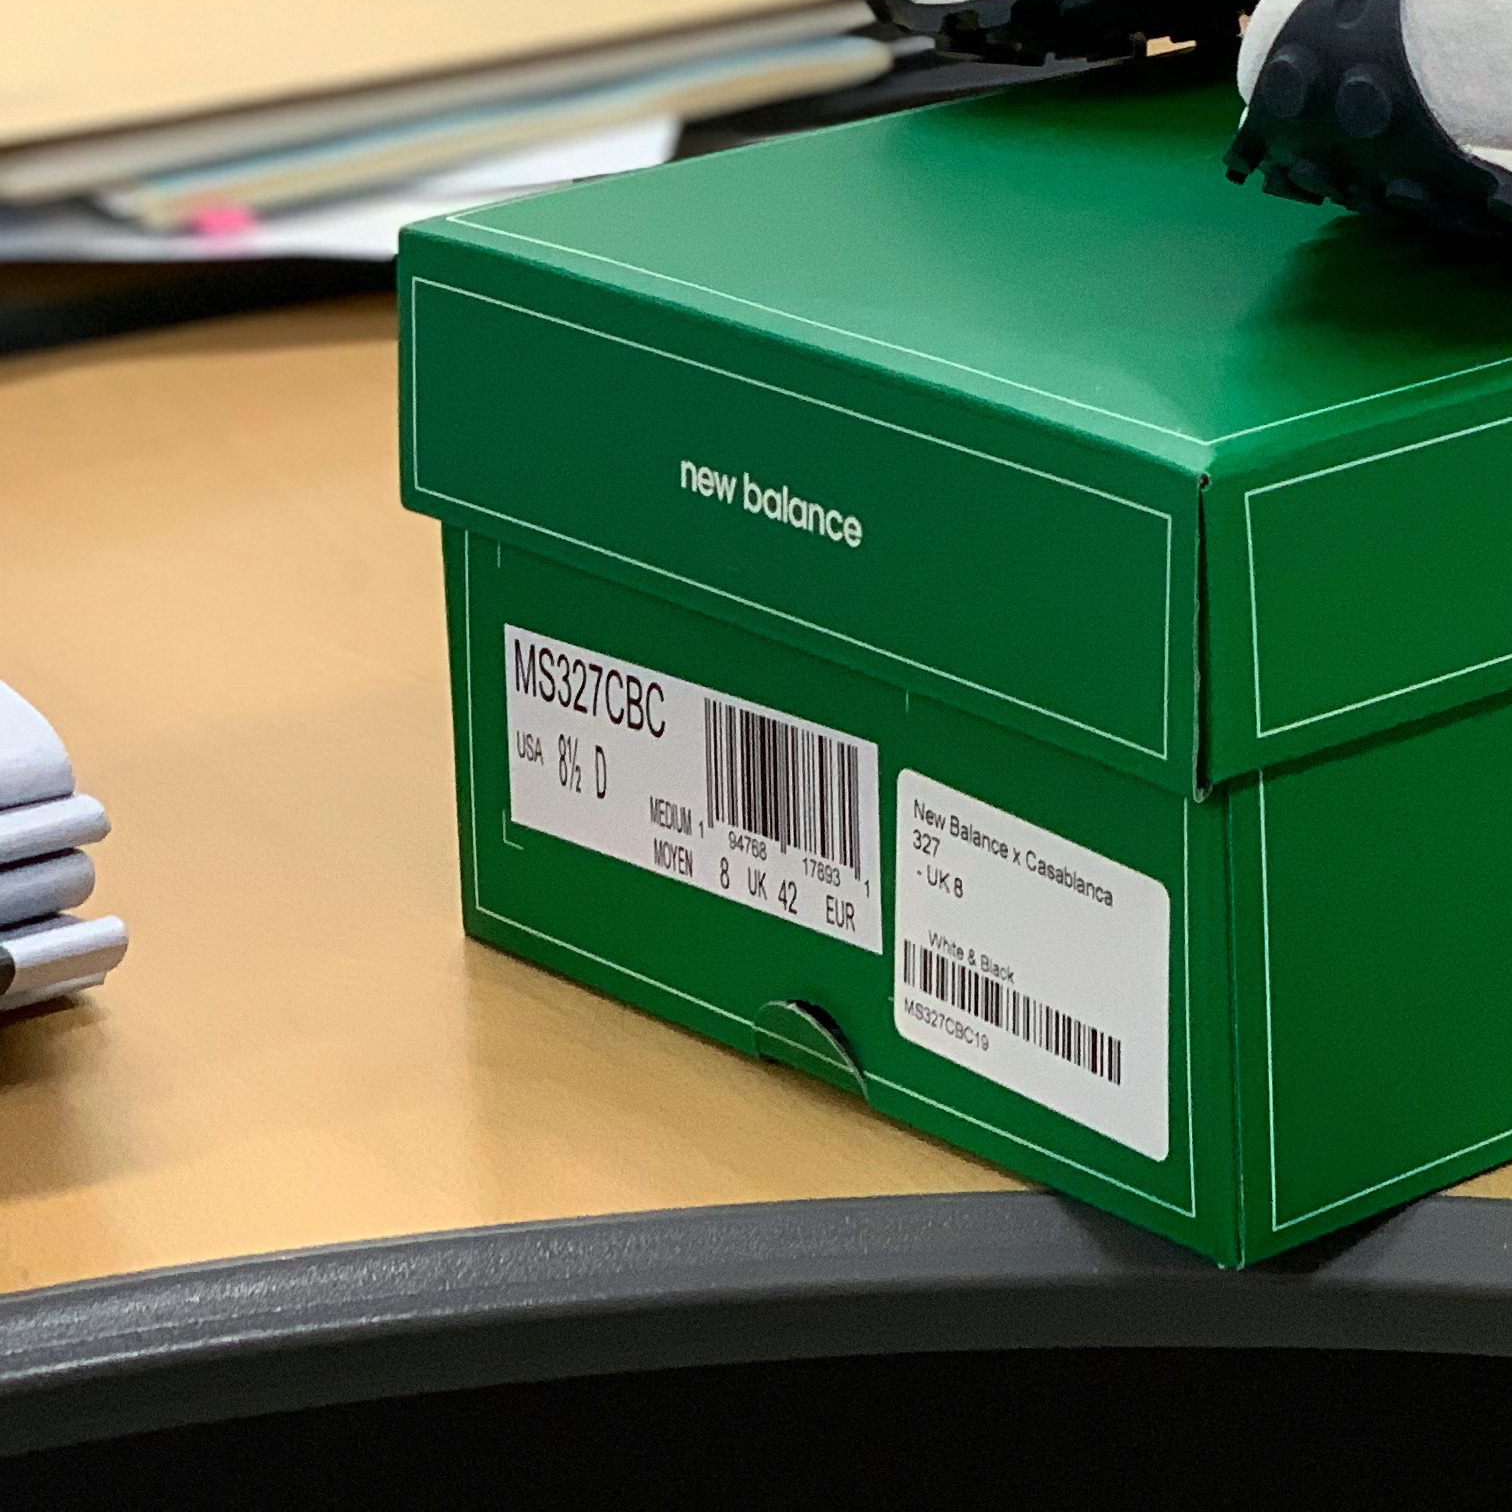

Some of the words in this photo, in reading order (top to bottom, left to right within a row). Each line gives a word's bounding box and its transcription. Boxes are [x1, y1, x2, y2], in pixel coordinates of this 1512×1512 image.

[681, 459, 738, 505] new
[743, 471, 863, 548] balance
[514, 638, 666, 738] MS327CBC
[516, 730, 545, 766] USA
[594, 744, 608, 800] D
[649, 795, 693, 836] MEDIUM
[912, 829, 941, 857] 327
[728, 830, 768, 861] 94768
[802, 857, 842, 887] 17893
[913, 798, 946, 831] New
[949, 815, 1009, 859] Balance
[1012, 846, 1021, 866] x
[1025, 849, 1114, 907] Casablanca
[653, 837, 694, 878] MOYEN
[719, 856, 730, 889] 8
[747, 867, 768, 900] UK
[777, 879, 798, 915] 42
[825, 894, 856, 932] EUR
[926, 864, 951, 894] UK
[953, 877, 964, 899] 8
[928, 929, 965, 961] White
[967, 948, 977, 967] &
[980, 954, 1015, 984] Black
[904, 996, 990, 1052] MS327CBC19
